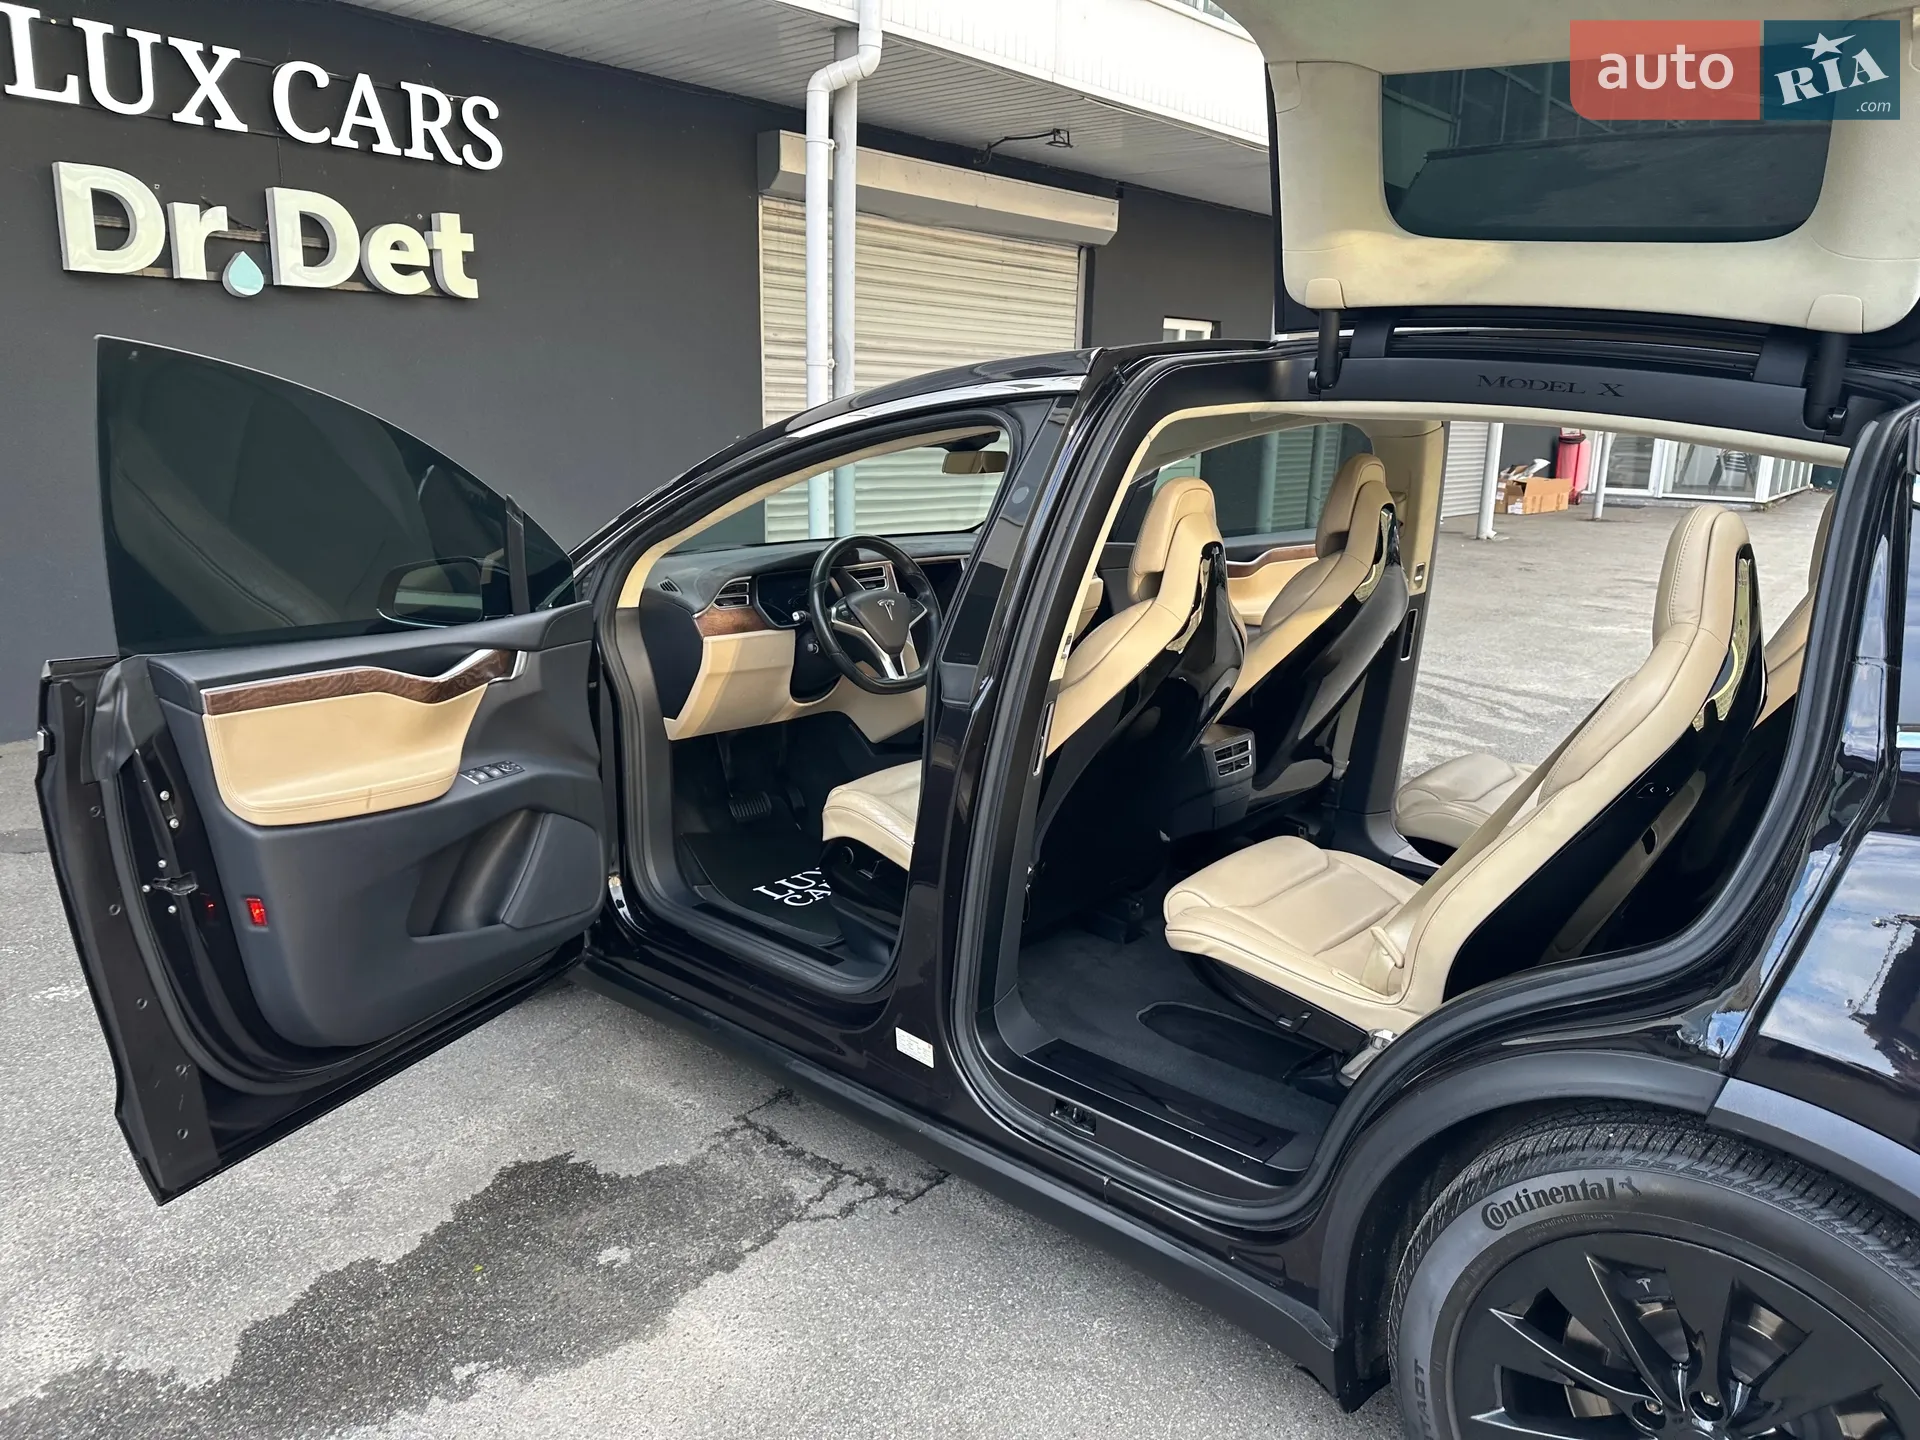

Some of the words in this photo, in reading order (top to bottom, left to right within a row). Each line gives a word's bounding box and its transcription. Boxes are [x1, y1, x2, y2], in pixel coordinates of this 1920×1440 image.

[0, 2, 249, 133] LUX
[271, 60, 503, 171] CARS
[1477, 374, 1586, 394] MODEL
[1597, 382, 1625, 398] X
[1480, 1177, 1617, 1231] Continental
